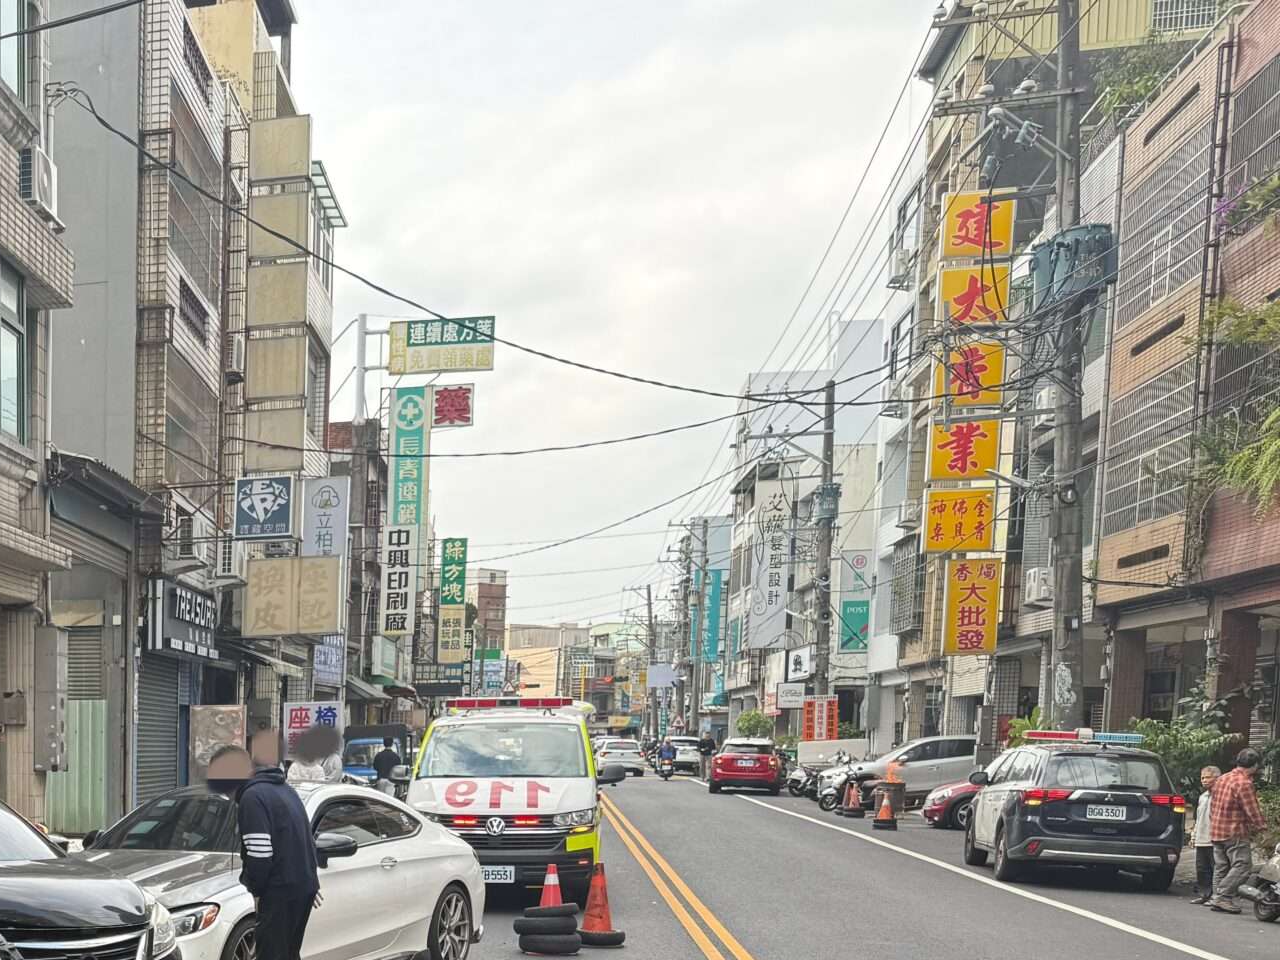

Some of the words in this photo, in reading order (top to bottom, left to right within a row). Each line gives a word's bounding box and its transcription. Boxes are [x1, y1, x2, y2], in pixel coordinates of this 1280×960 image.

[433, 385, 472, 425] 藥
[314, 511, 334, 555] 立柏
[384, 528, 411, 632] 中興印刷廠
[442, 540, 465, 602] 綠方塊
[953, 562, 997, 582] 香燭
[956, 582, 988, 651] 大批發
